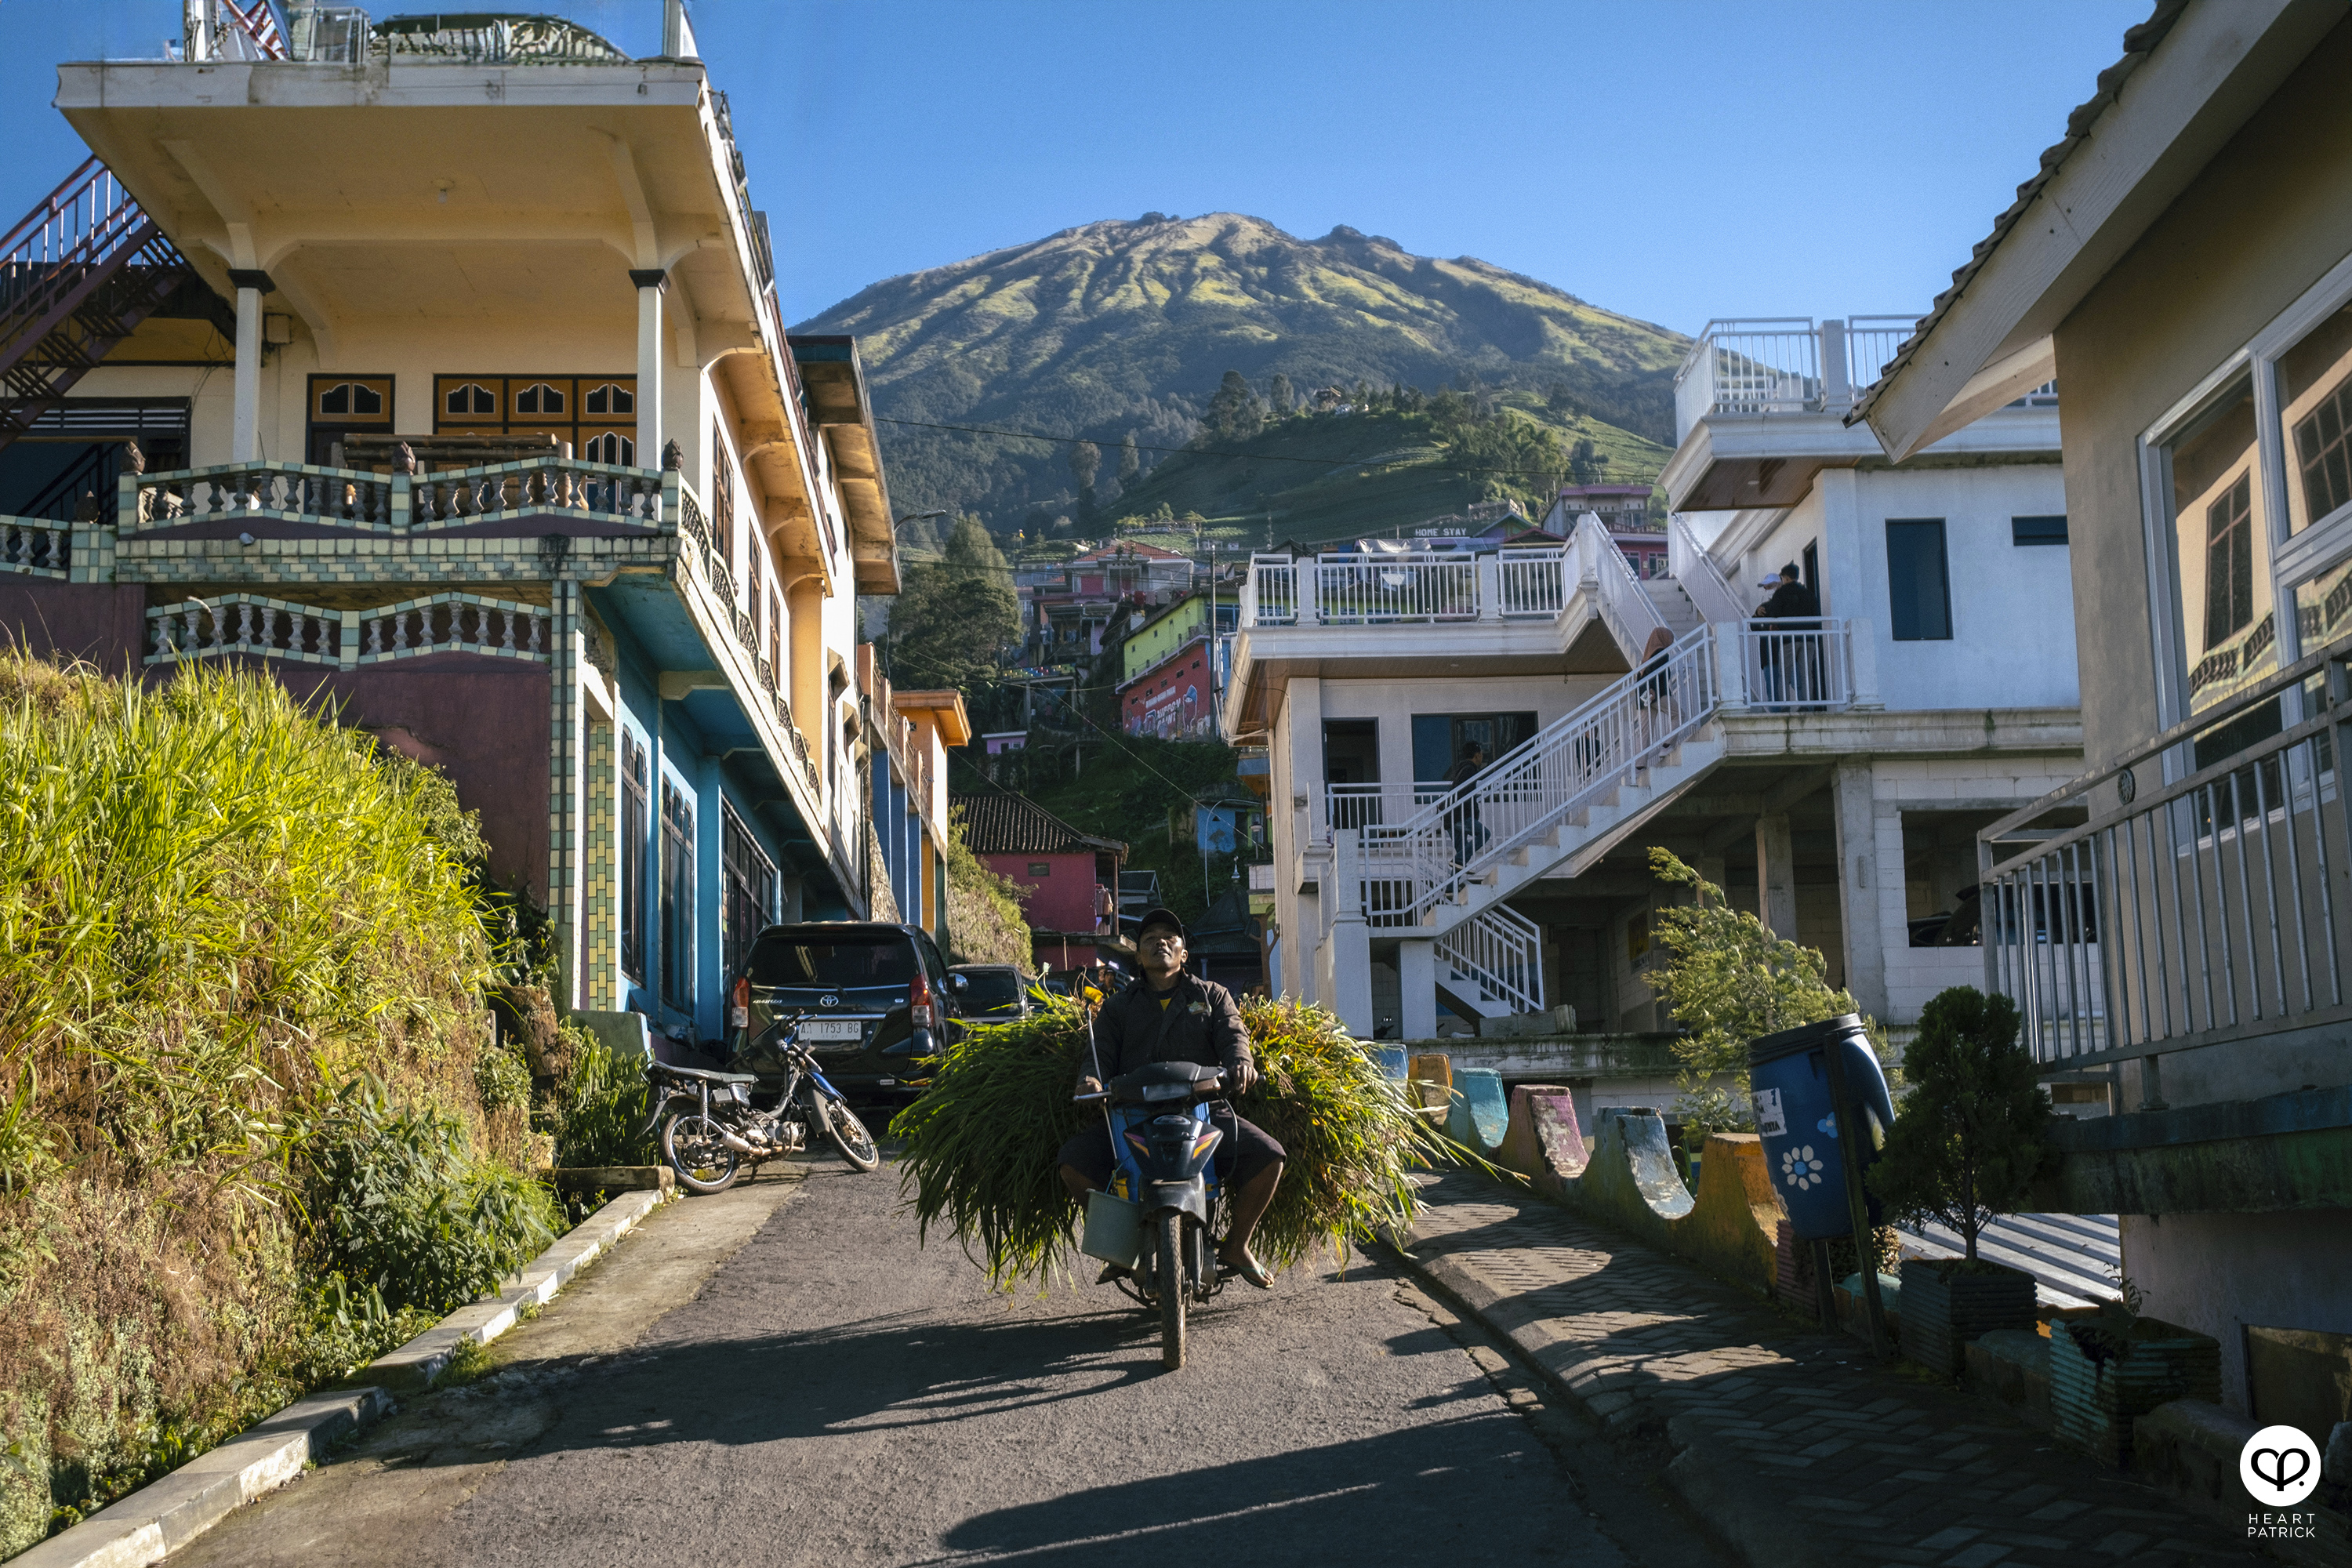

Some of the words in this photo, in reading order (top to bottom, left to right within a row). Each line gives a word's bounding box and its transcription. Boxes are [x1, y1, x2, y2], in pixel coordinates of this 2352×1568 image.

[1415, 528, 1439, 536] HOME
[1443, 528, 1467, 536] STAY
[820, 1022, 842, 1034] 1753
[848, 1022, 859, 1033] BG
